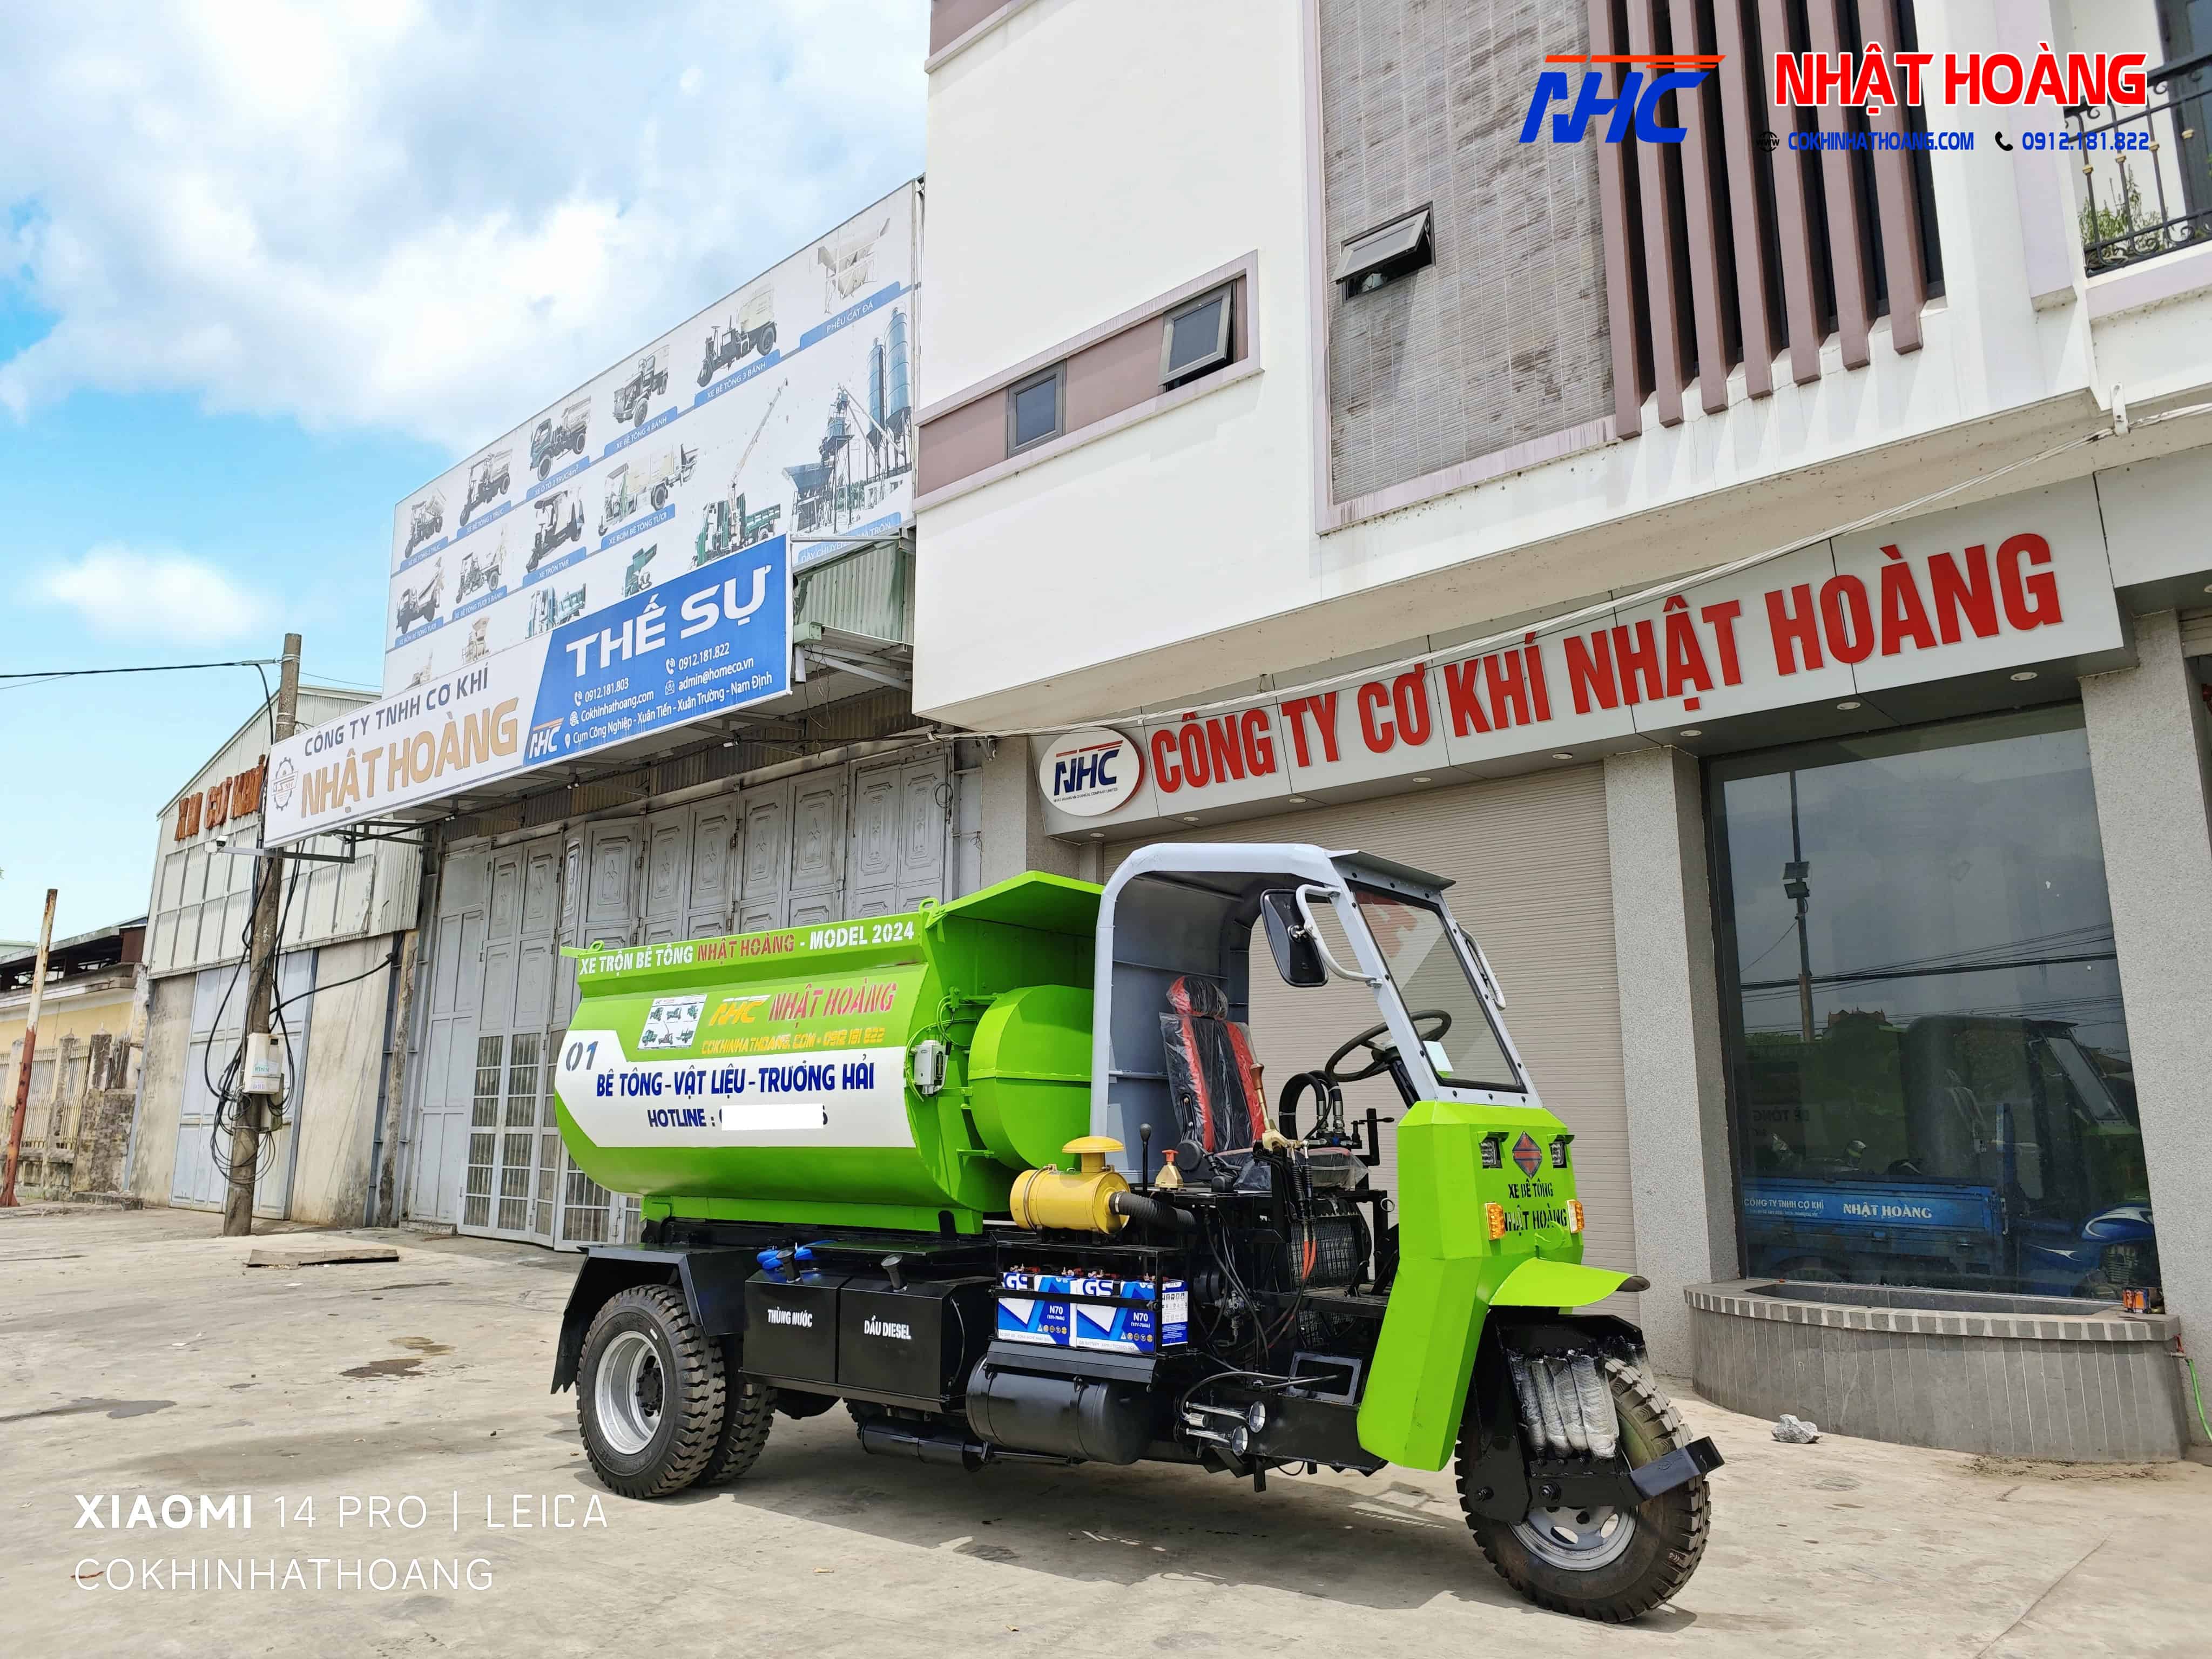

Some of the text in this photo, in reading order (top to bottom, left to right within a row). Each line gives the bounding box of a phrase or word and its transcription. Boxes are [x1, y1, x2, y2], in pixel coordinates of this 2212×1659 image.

[706, 360, 766, 399] XE BÊ TÔNG 3 BÁNH
[616, 440, 623, 450] XE
[630, 427, 646, 441] TÔNG
[651, 415, 667, 430] BÁNH
[609, 536, 616, 545] XE
[637, 517, 652, 532] TÔNG
[565, 565, 772, 678] THẾ SỰ
[678, 642, 730, 671] 0912.181.822
[1151, 534, 2063, 794] CÔNG TY CƠ KHÍ NHẬT HOÀNG
[678, 657, 754, 691] admin@homeco.vn
[581, 690, 655, 723] Cokhinhathoang.com
[585, 678, 629, 703] 0912.181.803
[589, 721, 606, 739] Công
[637, 708, 656, 725] Xuân
[677, 696, 696, 712] Xuân
[731, 678, 750, 696] Nam
[751, 671, 772, 691] Định
[304, 662, 489, 757] CÔNG TY TNHH CƠ KHÍ
[301, 697, 519, 819] NHẬT HOÀNG
[1054, 748, 1120, 796] NHC
[579, 956, 597, 975] XE
[599, 950, 633, 976] TRỘN
[636, 946, 652, 969] BÊ
[656, 943, 693, 966] TÔNG
[697, 938, 738, 965] NHẬT
[740, 932, 795, 957] HOÀNG
[810, 925, 868, 950] MODEL
[872, 920, 914, 943] 2024
[768, 982, 824, 1029] NHẬT
[822, 977, 898, 1017] HOÀNG
[565, 1040, 599, 1072] 01
[596, 1069, 614, 1097] BÊ
[619, 1067, 663, 1097] TÔNG
[673, 1064, 707, 1101] VẬT
[711, 1063, 746, 1100] LIỆU
[842, 1053, 875, 1090] HẢI
[648, 1108, 707, 1128] HOTLINE
[1508, 1177, 1554, 1199] XE BÊ TÔNG
[1744, 1197, 1768, 1207] CÔNG
[1769, 1199, 1777, 1208] TY
[1778, 1200, 1796, 1209] TNHH
[1843, 1202, 1932, 1219] NHẬT HOÀNG
[1004, 1272, 1028, 1290] GS
[1082, 1279, 1113, 1297] GS
[767, 1306, 813, 1328] THÙNG NƯỚC
[1049, 1305, 1063, 1315] N70
[1134, 1312, 1149, 1322] N70
[864, 1314, 912, 1340] DẦU DIESEL
